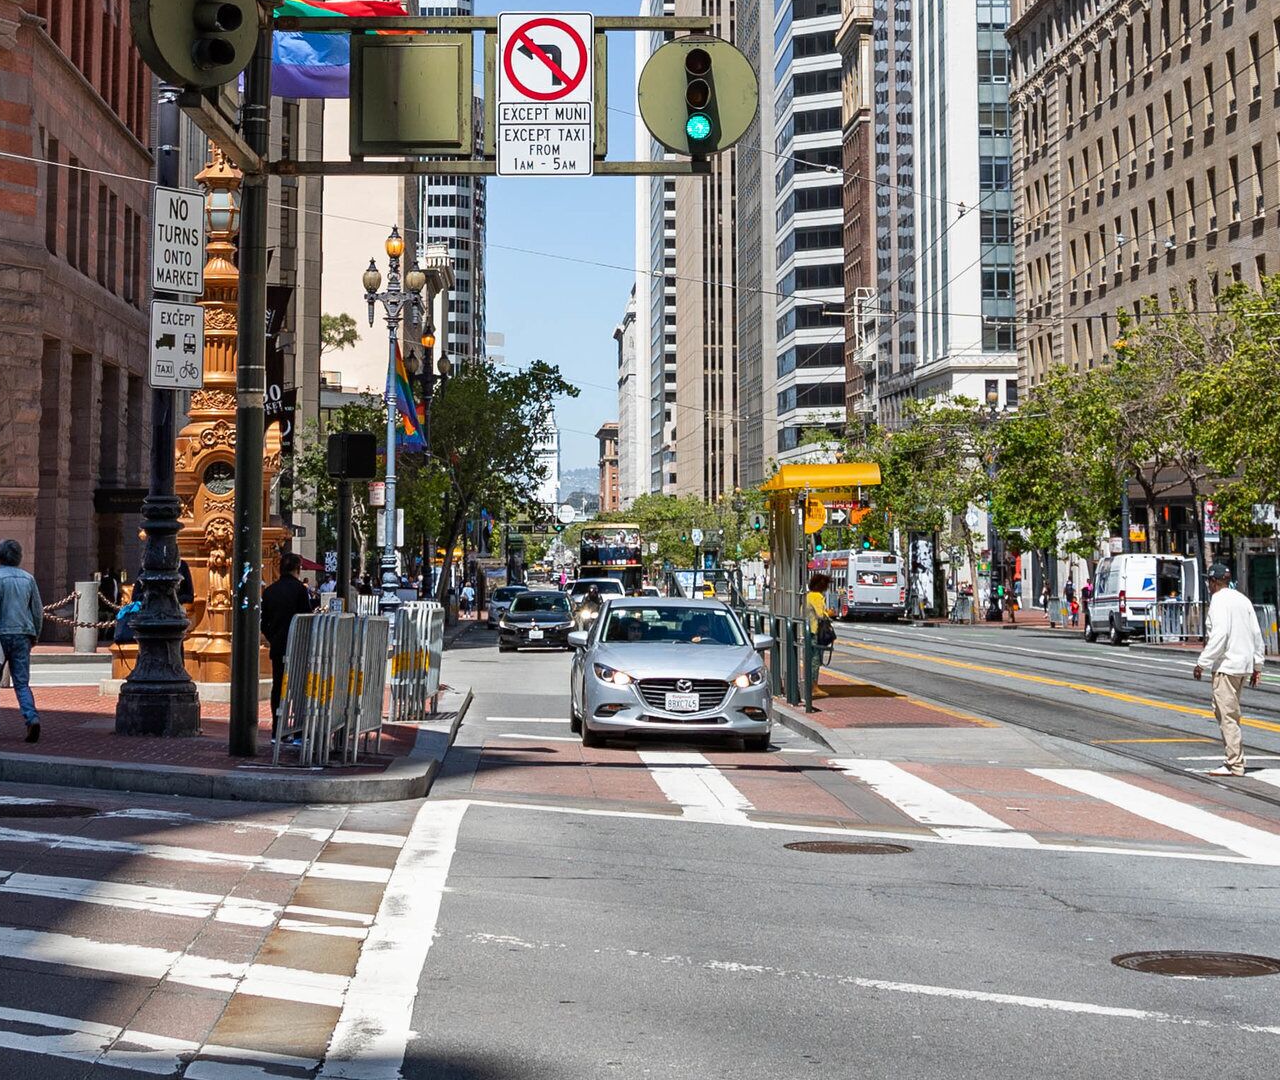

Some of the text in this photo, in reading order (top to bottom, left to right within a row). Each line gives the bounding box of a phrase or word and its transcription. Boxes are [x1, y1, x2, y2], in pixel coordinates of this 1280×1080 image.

[503, 107, 587, 121] EXCEPT MUNI
[504, 128, 585, 142] EXCEPT TAXI
[529, 144, 560, 156] FROM
[514, 157, 534, 170] 1AM
[553, 157, 576, 170] 5AM
[169, 197, 189, 221] NO
[158, 223, 199, 247] TURNS
[164, 248, 192, 267] ONTO
[156, 267, 199, 287] MARKET
[161, 311, 196, 327] EXCEPT
[156, 363, 173, 375] TAXI
